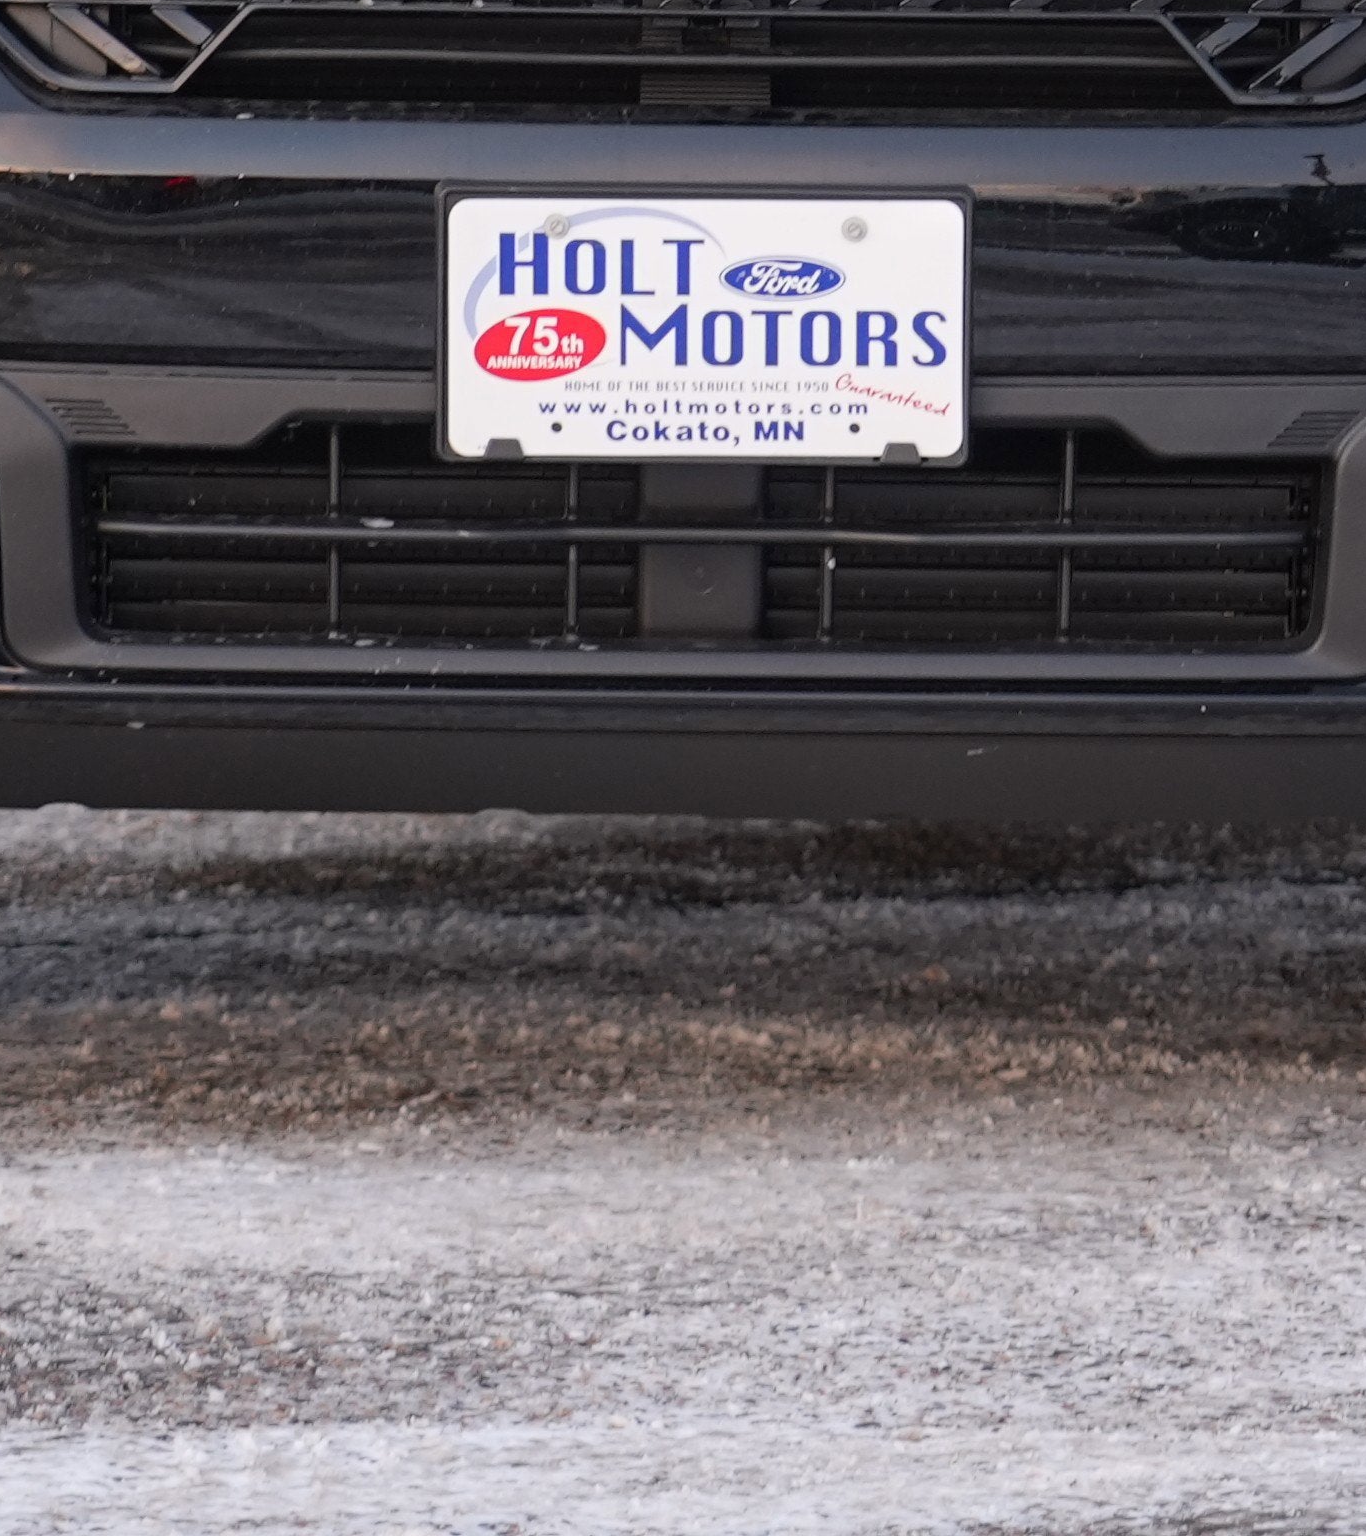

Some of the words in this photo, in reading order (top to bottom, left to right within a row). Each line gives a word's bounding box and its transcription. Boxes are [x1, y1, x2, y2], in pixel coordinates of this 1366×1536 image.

[498, 232, 705, 296] HOLT
[742, 260, 823, 295] Ford
[503, 315, 585, 357] 75th
[620, 303, 947, 367] MOTORS
[485, 355, 583, 370] ANNIVERSARY
[564, 380, 602, 392] HOME
[608, 380, 622, 392] OF
[628, 380, 650, 392] THE
[655, 380, 687, 392] BEST
[692, 380, 745, 392] SERVICE
[751, 380, 790, 393] SINCE
[796, 380, 830, 393] 1950
[834, 373, 951, 416] Guaranteed
[538, 398, 869, 415] www.holtmotors.com
[606, 420, 741, 444] Cokato,
[754, 421, 806, 442] MN
